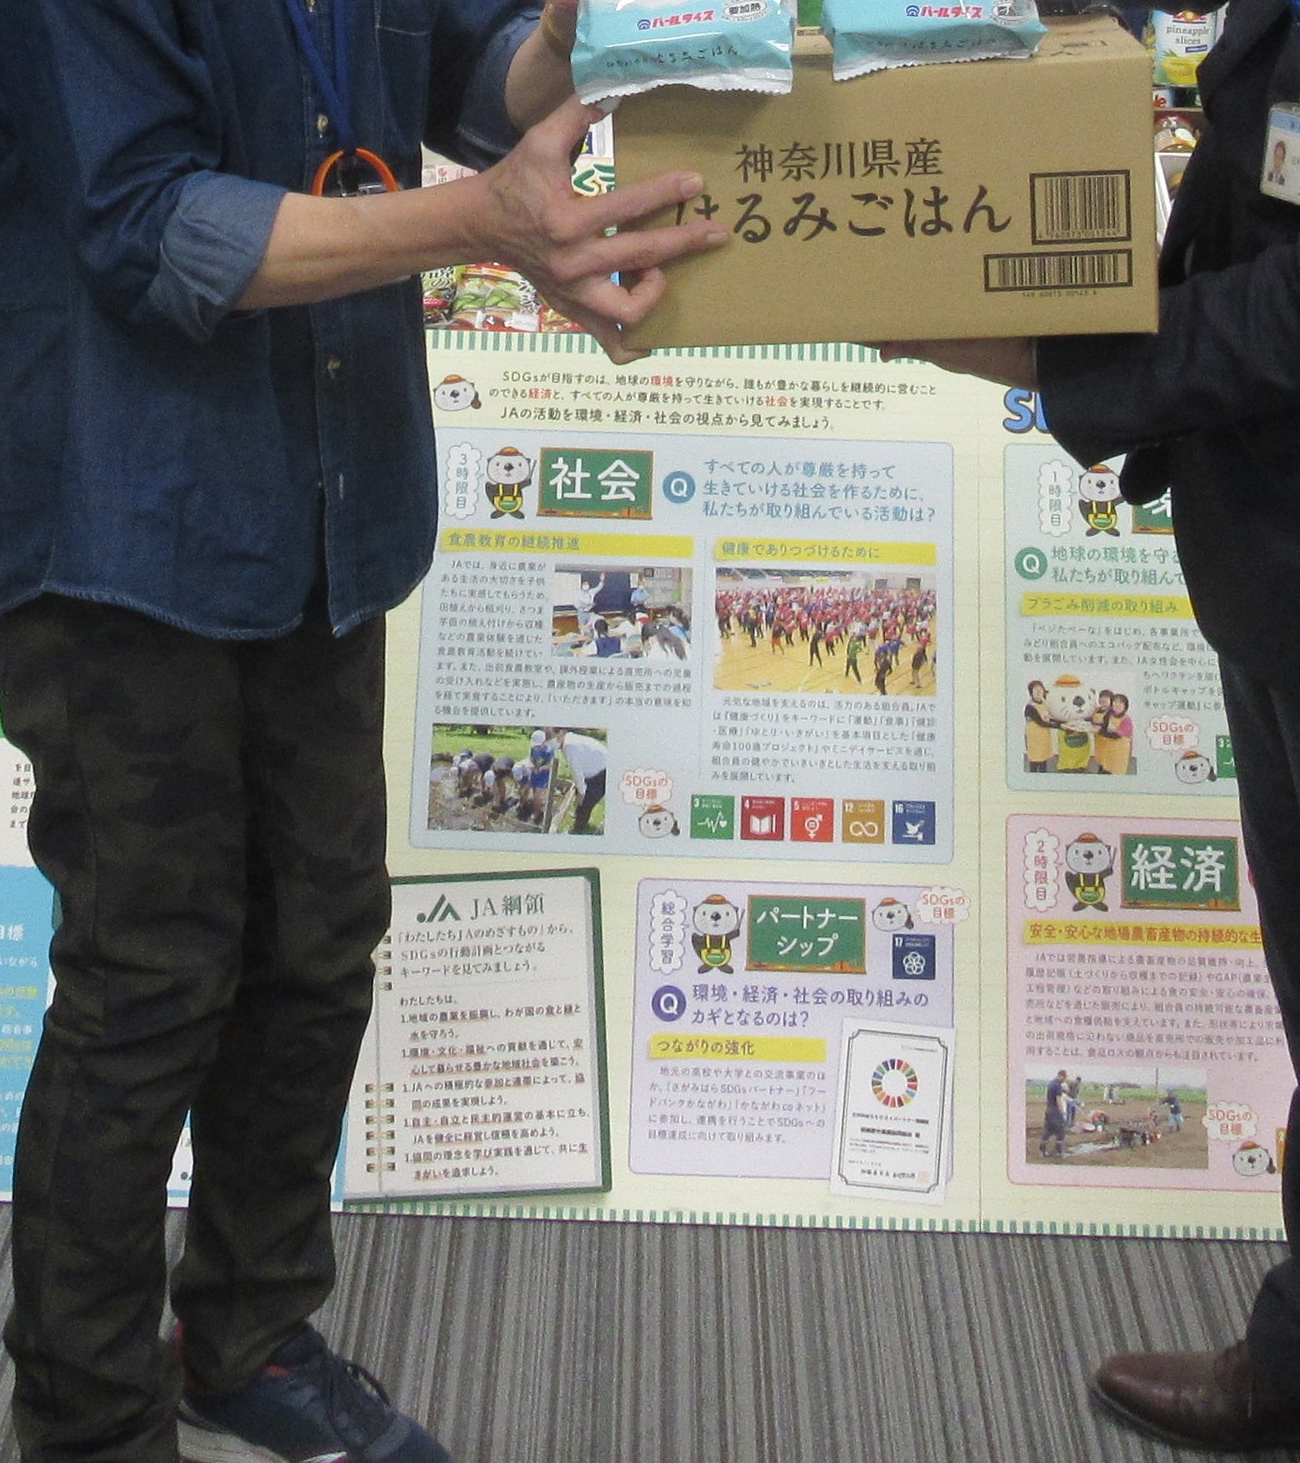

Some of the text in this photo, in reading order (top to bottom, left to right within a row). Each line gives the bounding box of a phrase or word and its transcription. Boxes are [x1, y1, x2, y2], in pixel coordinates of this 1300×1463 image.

[652, 10, 714, 28] パールライス
[1166, 25, 1209, 36] pineapple
[735, 138, 943, 183] 神奈川県産
[549, 457, 640, 501] 社会
[704, 459, 896, 479] すべての人が尊厳を持って
[456, 454, 469, 509] 3時限目
[670, 478, 688, 498] Q
[703, 480, 924, 501] 生きていける社会を作るために、
[703, 501, 936, 522] 私たちが取り組んでいる活動は？
[722, 542, 880, 558] 健康でありつづけるために
[1023, 553, 1040, 574] Q
[1028, 598, 1178, 613] プラごみ削減の取り組み
[1151, 722, 1194, 734] SDGsの
[625, 776, 668, 787] SDGsの
[1034, 840, 1049, 901] 2時限目
[1130, 844, 1225, 892] 経済
[470, 893, 545, 920] JA綱領
[757, 908, 858, 930] パートナー
[660, 902, 674, 964] 総合学習
[777, 935, 838, 958] シップ
[401, 961, 537, 977] キーワードを見てみましょう。
[660, 994, 679, 1015] Q
[692, 984, 929, 1008] 環境・経済・社会の取り組みの
[691, 1010, 810, 1028] カギとなるのは？
[657, 1039, 754, 1056] つながりの強化
[1209, 1109, 1252, 1122] SDGsの
